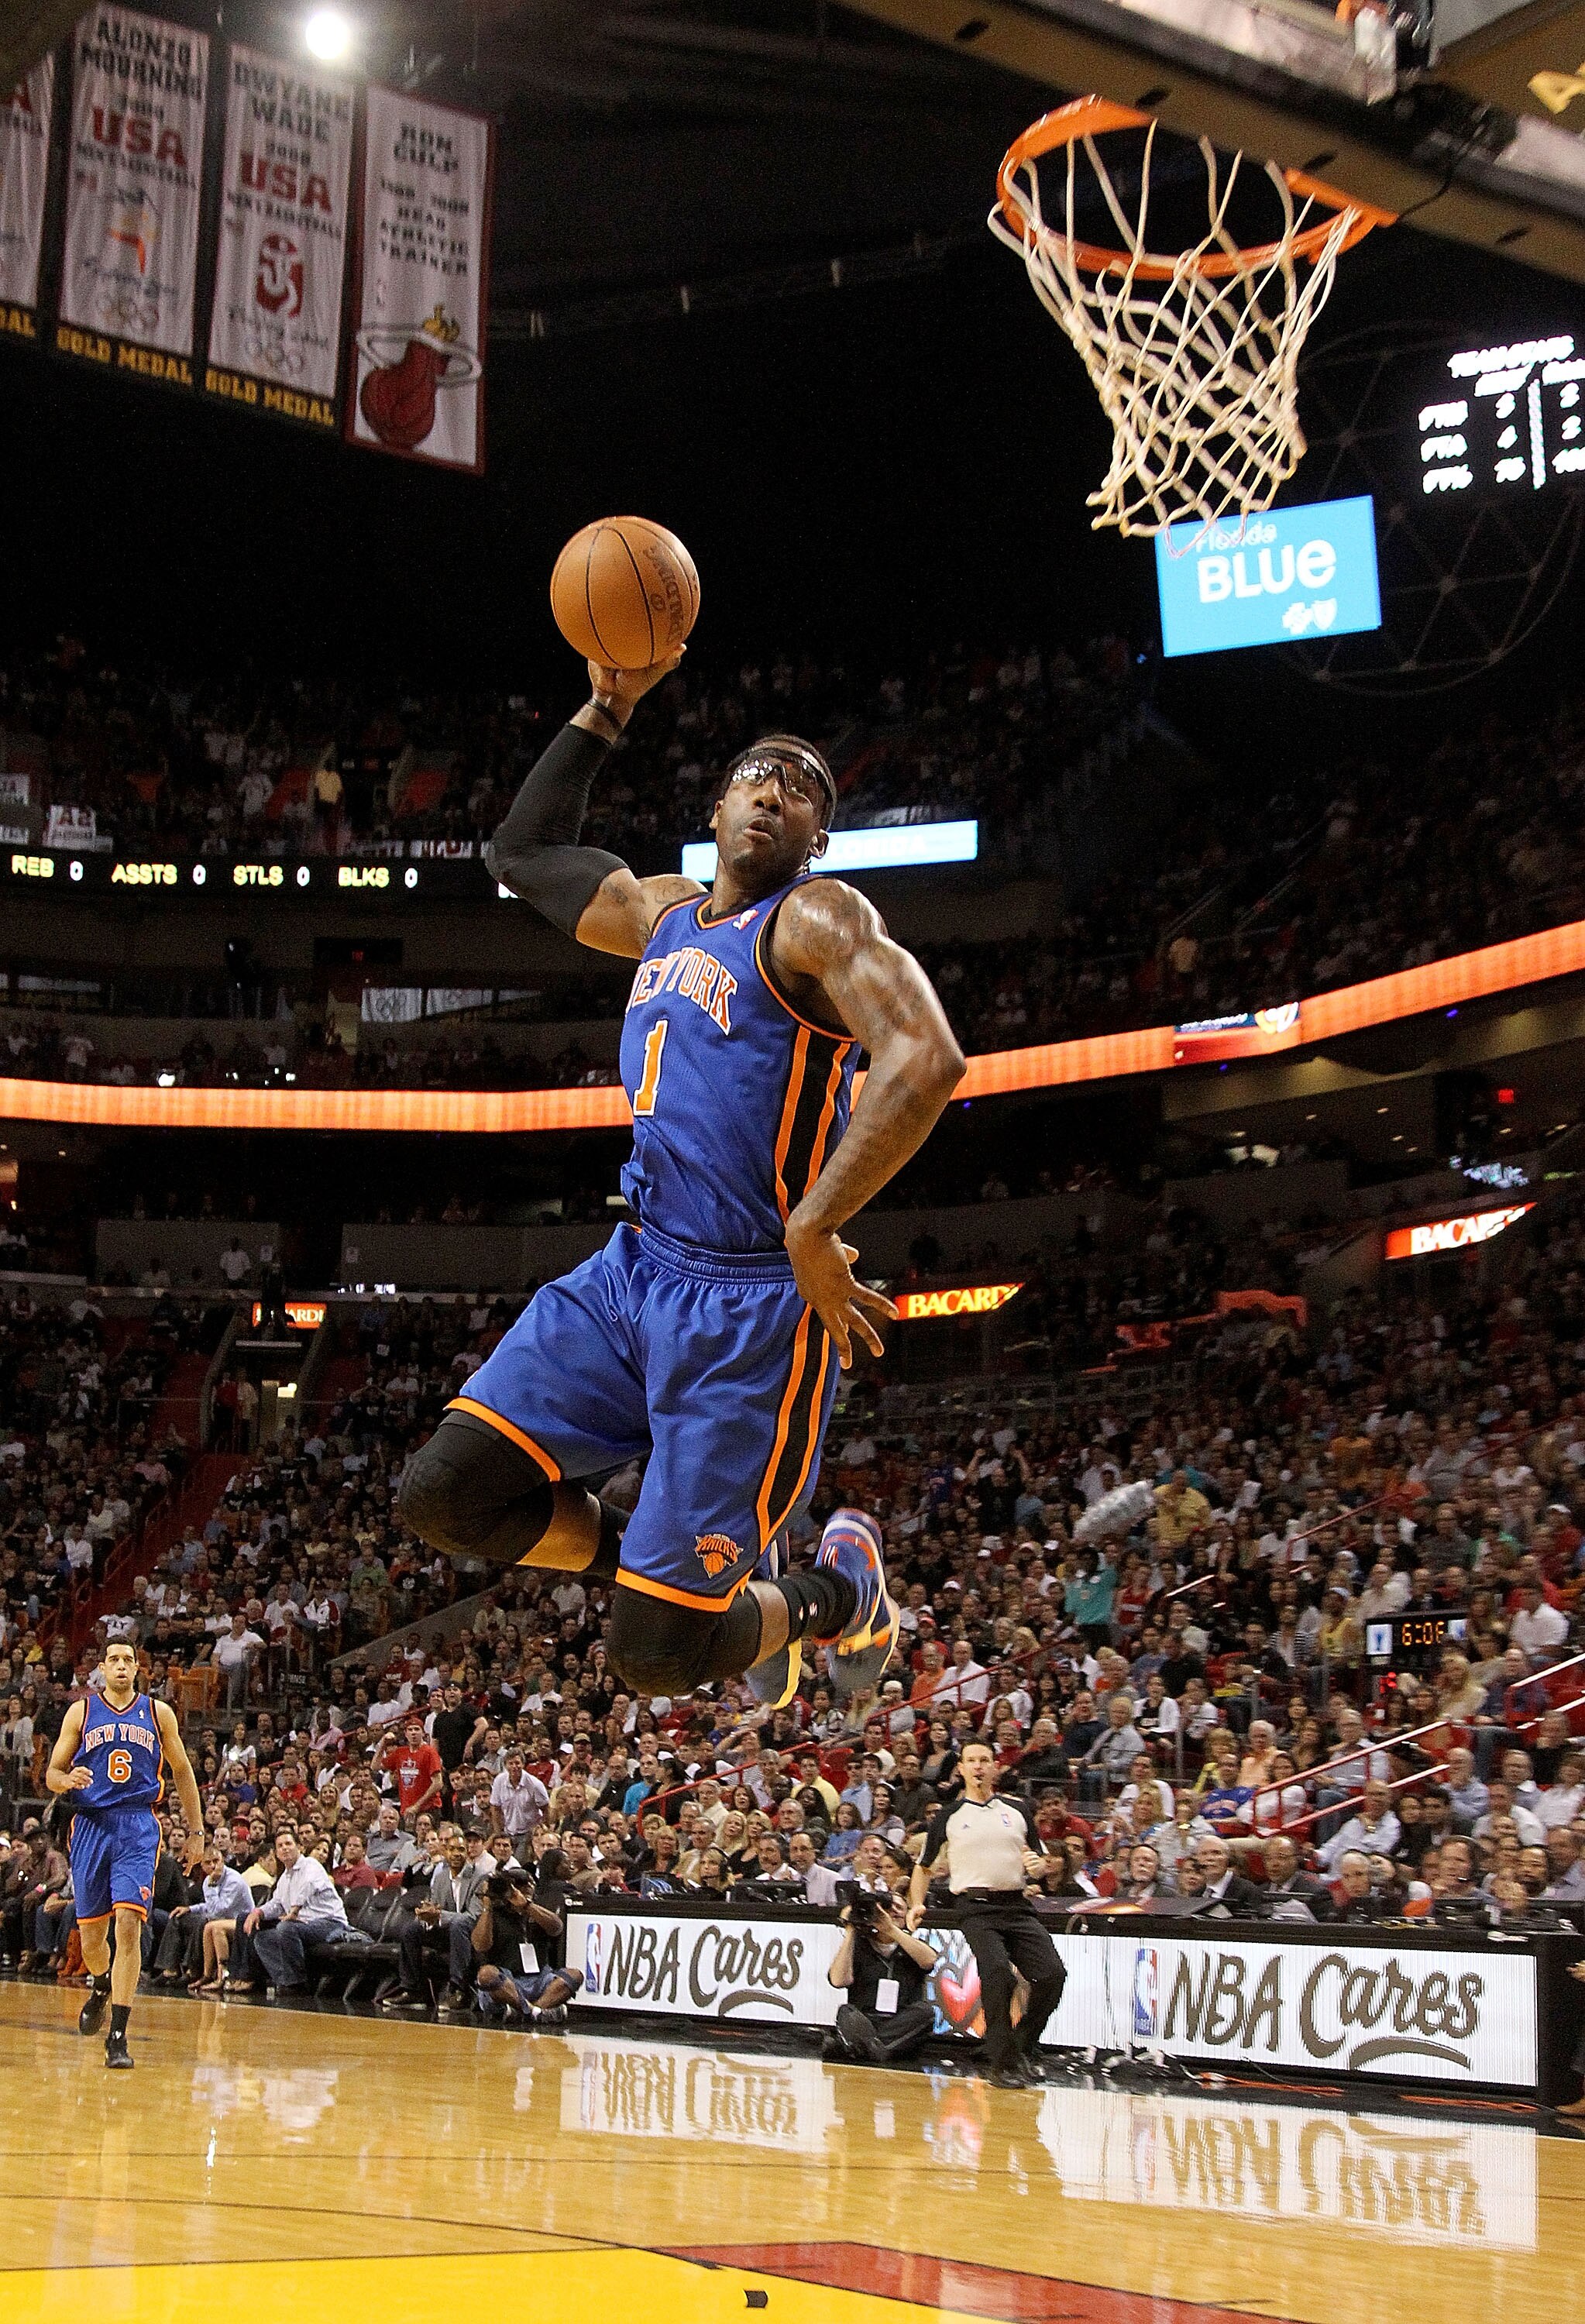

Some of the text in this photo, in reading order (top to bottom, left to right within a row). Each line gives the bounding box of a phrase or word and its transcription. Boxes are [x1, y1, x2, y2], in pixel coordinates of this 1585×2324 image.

[92, 106, 188, 167] USA
[240, 153, 333, 215] USA
[12, 855, 418, 889] REB 0 ASSTS 0 STLS 0 BLKS 0
[665, 947, 737, 1036] YORK
[633, 1019, 668, 1116] 1
[85, 1723, 155, 1754] NEW YORK
[108, 1748, 132, 1783] 6
[603, 1923, 804, 2008] NBA Cares
[1164, 1950, 1484, 2059] NBA Cares
